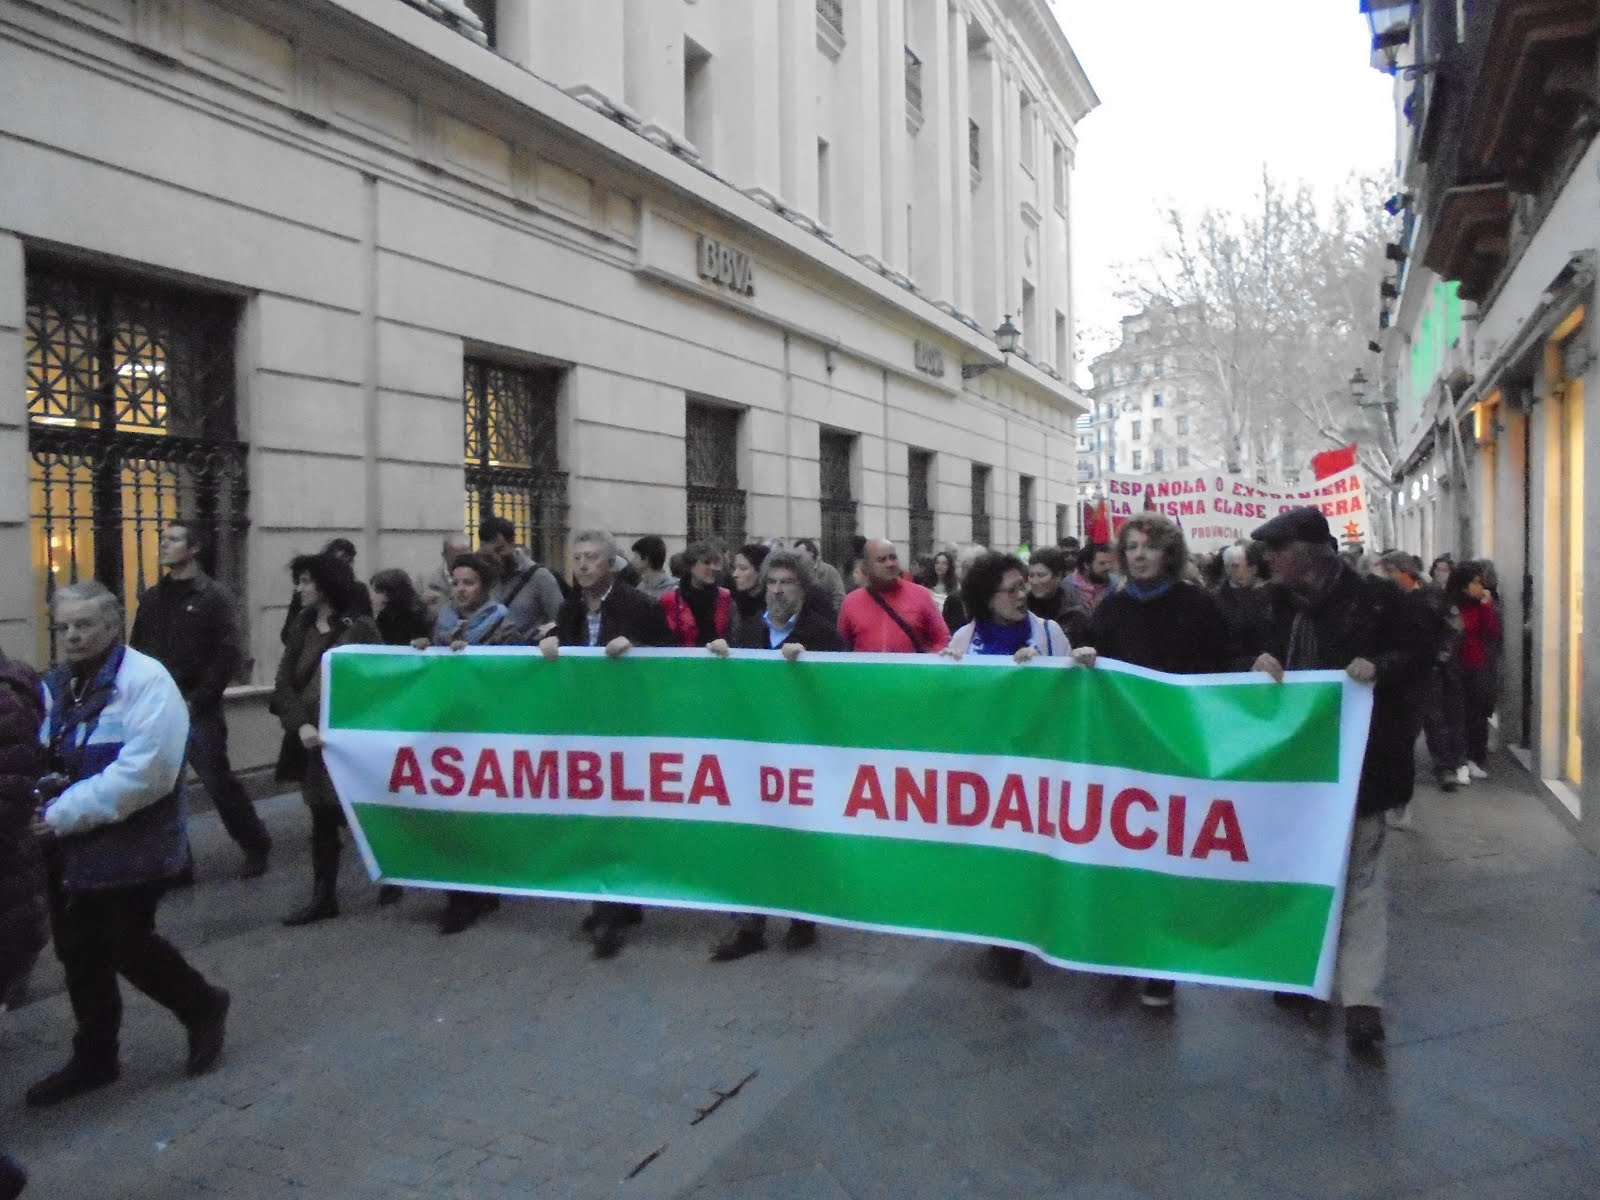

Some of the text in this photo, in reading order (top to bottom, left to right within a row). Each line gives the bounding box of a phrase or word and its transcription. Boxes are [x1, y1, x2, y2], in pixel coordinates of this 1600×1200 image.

[696, 234, 754, 298] BBVA
[1110, 499, 1132, 515] LA
[1213, 497, 1266, 519] CLASE
[1279, 496, 1362, 517] OERA
[388, 746, 1249, 862] ASAMBLEA DE ANDALUCIA
